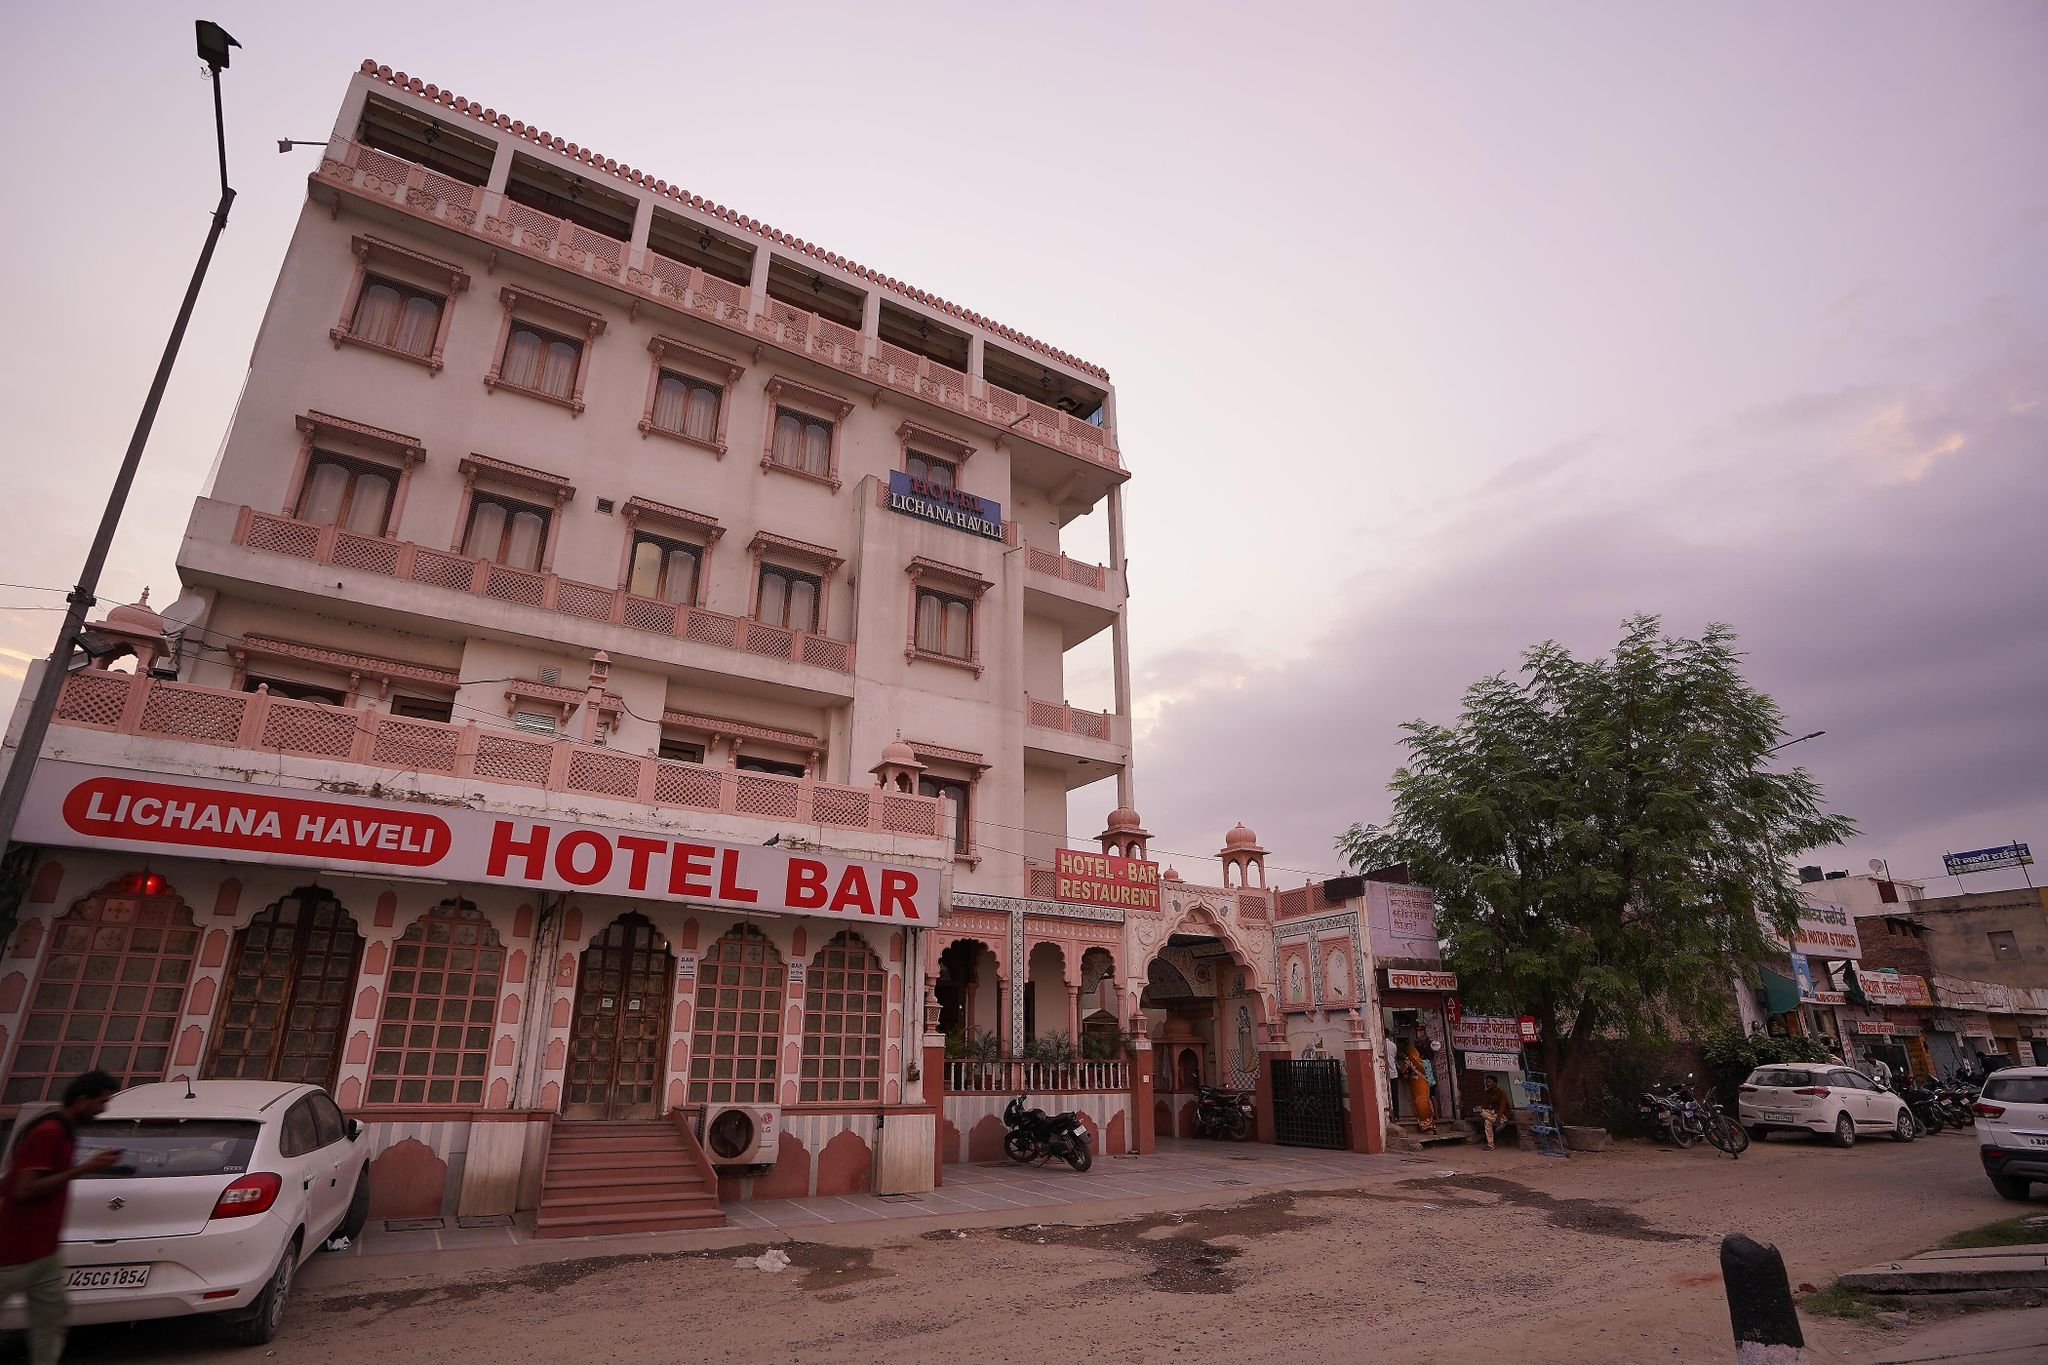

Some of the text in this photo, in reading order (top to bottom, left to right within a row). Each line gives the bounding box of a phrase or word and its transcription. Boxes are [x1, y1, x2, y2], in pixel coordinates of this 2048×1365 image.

[911, 478, 985, 514] HOTEL
[892, 492, 1003, 539] LICHANA HAVELI
[85, 791, 435, 854] LICHANA HAVELI
[486, 820, 920, 920] HOTEL BAR
[1060, 853, 1157, 885] HOTEL BAR
[1060, 878, 1158, 908] RESTAURENT
[1830, 932, 1857, 948] STORES
[1447, 997, 1456, 1021] ATM
[1523, 1034, 1537, 1043] ATM
